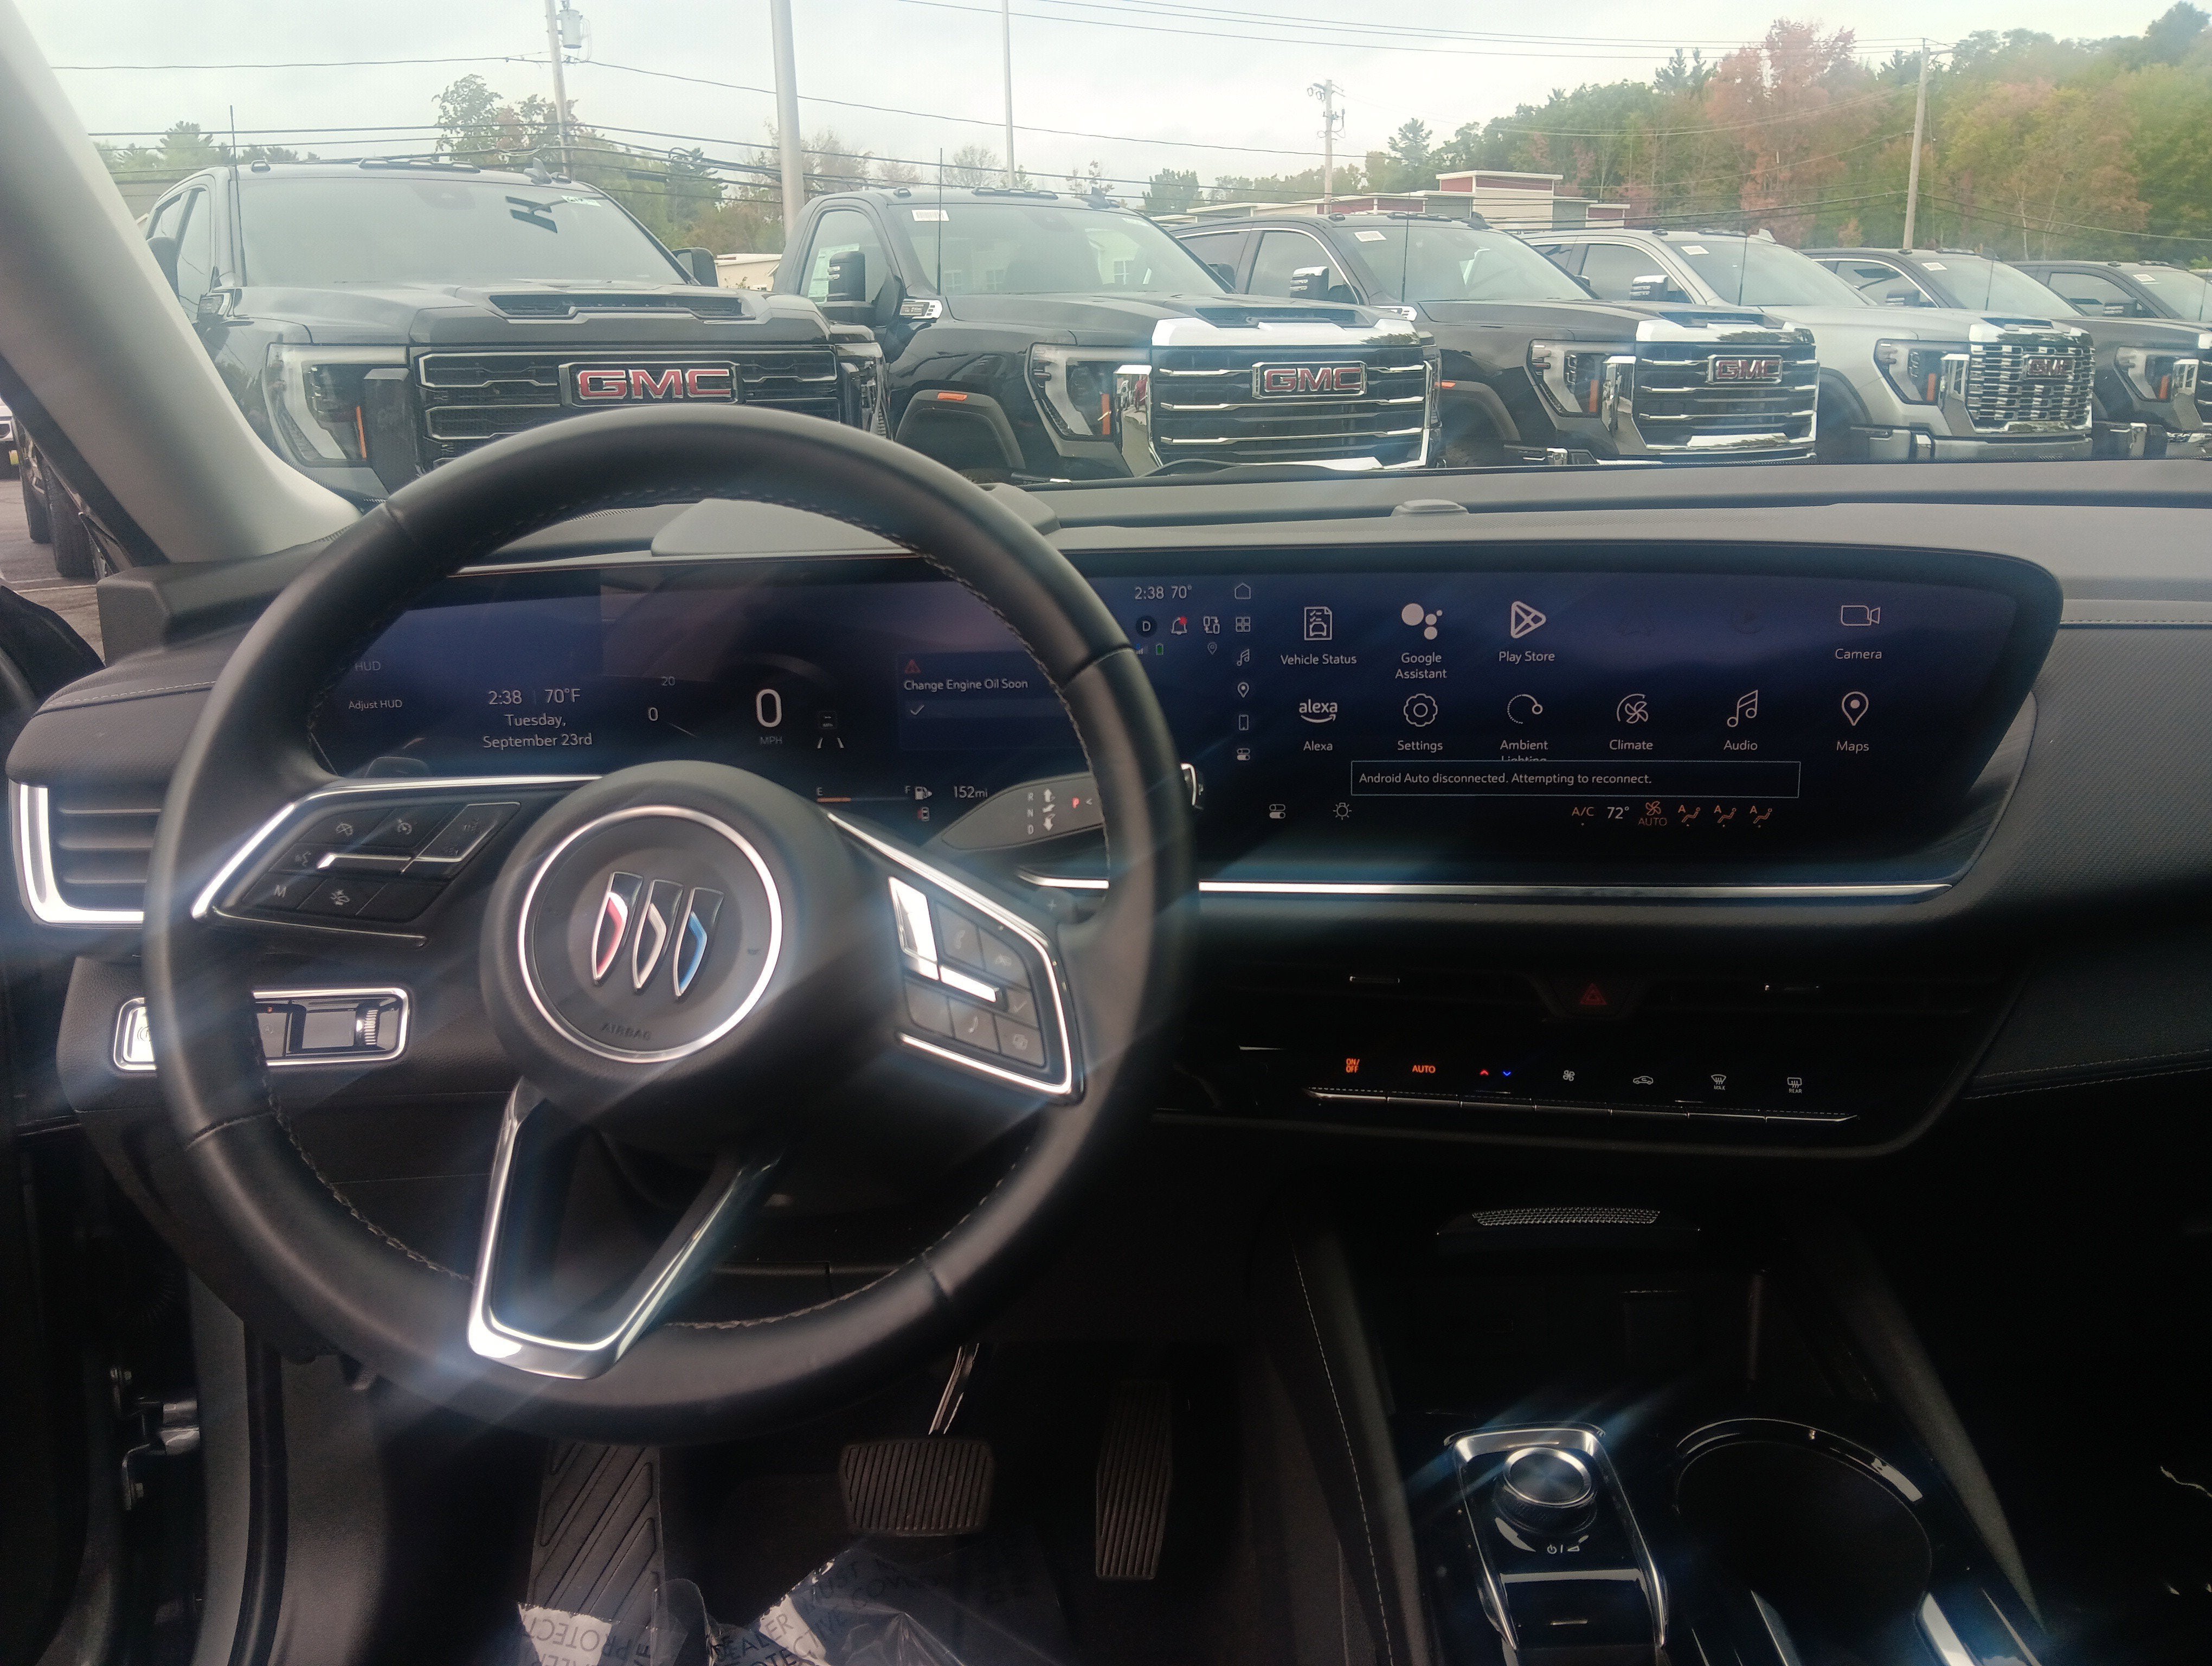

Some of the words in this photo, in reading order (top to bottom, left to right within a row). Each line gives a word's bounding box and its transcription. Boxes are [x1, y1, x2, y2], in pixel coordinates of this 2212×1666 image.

[1716, 360, 1780, 379] GMC
[577, 369, 731, 400] GMC
[1264, 367, 1363, 393] GMC
[1135, 586, 1164, 600] 2:38
[1171, 585, 1192, 599] 70°
[1142, 620, 1151, 632] D
[1280, 653, 1319, 665] Vehicle
[1322, 653, 1357, 664] Status
[1401, 651, 1442, 666] Google
[1499, 651, 1522, 665] Play
[1525, 650, 1555, 662] Store
[1835, 648, 1882, 659] Camera
[355, 660, 381, 671] HUD
[1395, 668, 1448, 679] Assistant
[660, 676, 676, 686] 20
[903, 680, 944, 693] Change
[946, 679, 982, 692] Engine
[984, 678, 999, 689] Oil
[1001, 678, 1028, 689] Soon
[488, 690, 522, 705] 2:38
[544, 688, 581, 703] 70°F
[348, 700, 378, 712] Adjust
[380, 699, 403, 708] HUD
[756, 688, 782, 728] 0
[1298, 699, 1338, 714] alexa
[648, 707, 658, 721] 0
[504, 713, 566, 728] Tuesday,
[483, 734, 558, 751] September
[561, 733, 593, 746] 23rd
[760, 736, 783, 745] MPH
[1303, 740, 1333, 751] Alexa
[1397, 740, 1443, 753] Settings
[1500, 739, 1548, 750] Ambient
[1609, 739, 1654, 750] Climate
[1723, 740, 1758, 751] Audio
[1836, 740, 1869, 754] Maps
[1359, 772, 1401, 783] Android
[1404, 773, 1430, 783] Auto
[1432, 772, 1508, 783] disconnected.
[1511, 773, 1574, 786] Attempting
[1577, 774, 1589, 784] to
[1592, 774, 1652, 784] reconnect.
[816, 787, 824, 796] E
[904, 785, 911, 794] F
[1072, 797, 1080, 809] P
[1677, 804, 1686, 813] A
[1714, 805, 1722, 813] A
[1571, 806, 1594, 817] A/C
[1607, 806, 1630, 819] 72°
[1750, 805, 1758, 814] A
[1637, 816, 1668, 826] AUTO
[1412, 1065, 1436, 1073] AUTO
